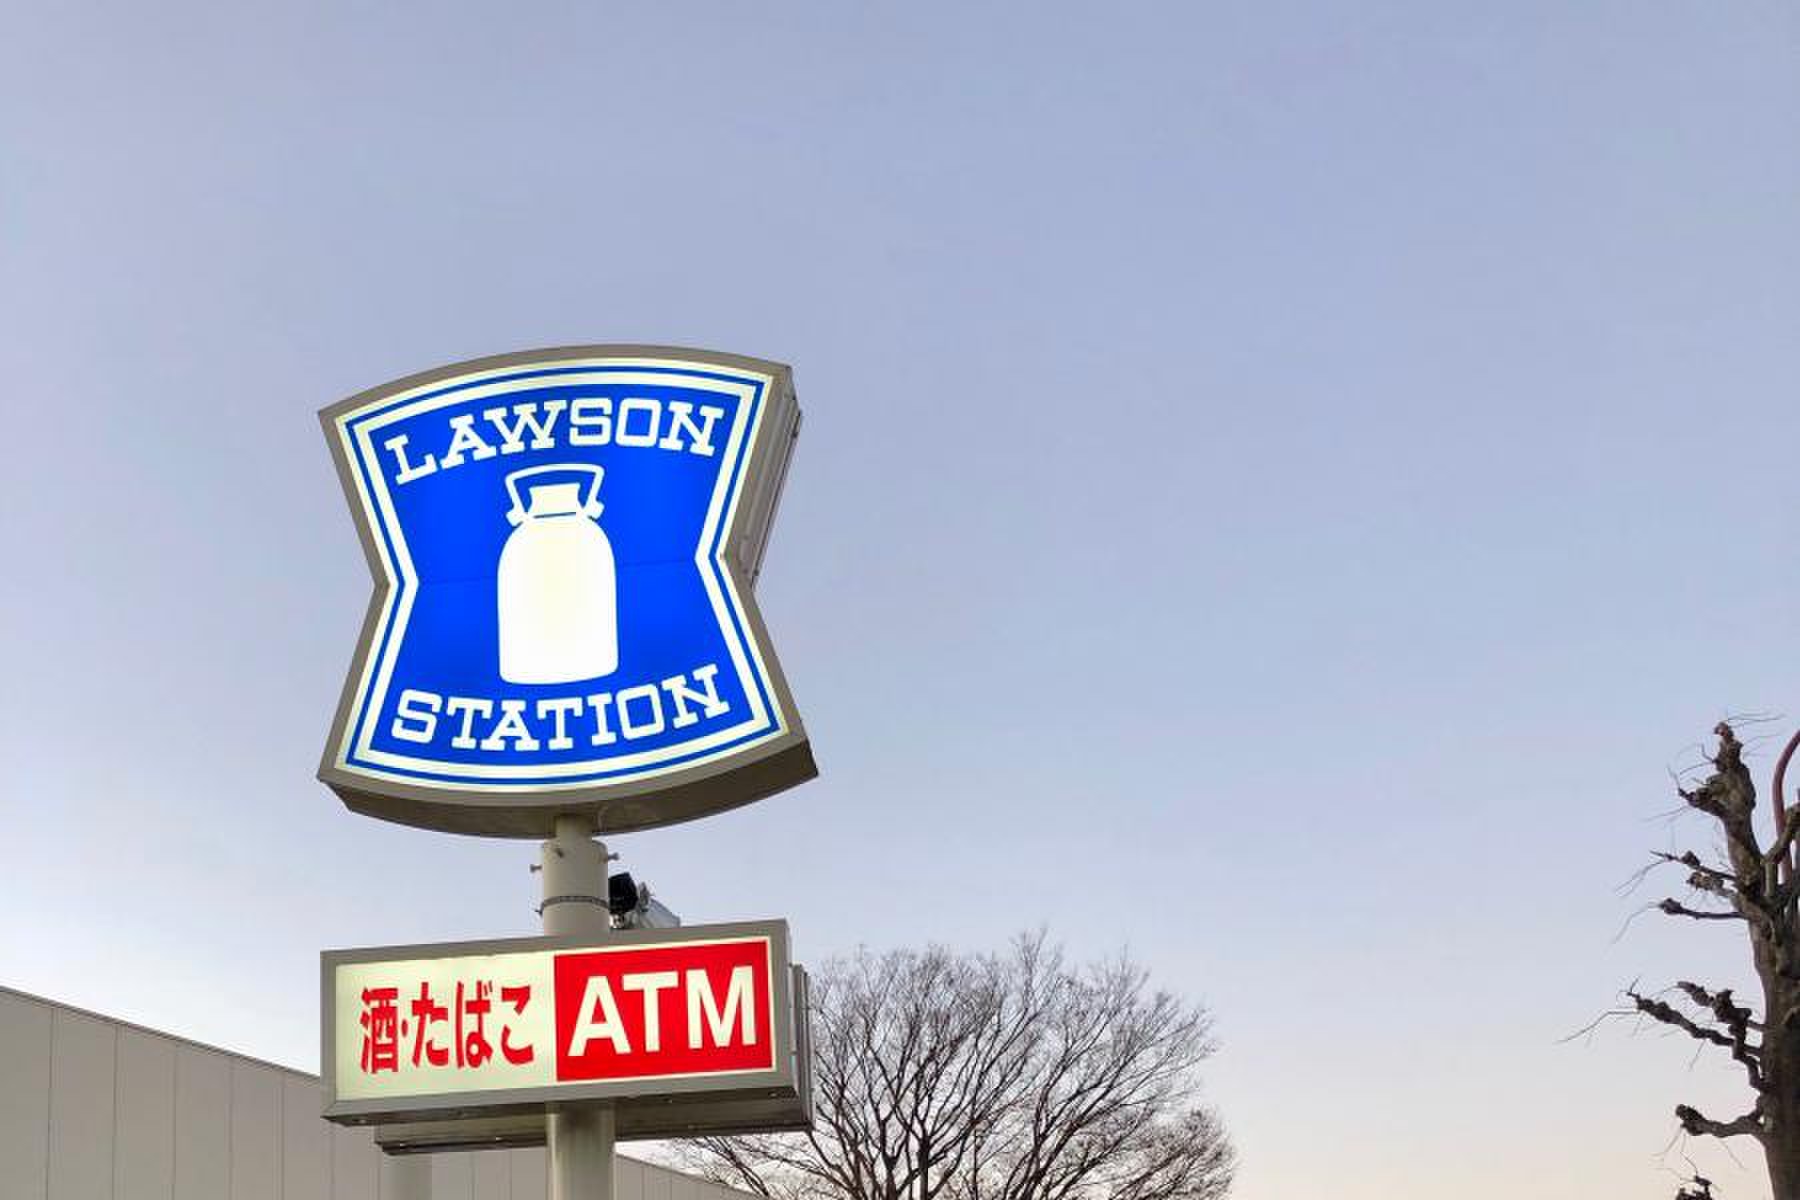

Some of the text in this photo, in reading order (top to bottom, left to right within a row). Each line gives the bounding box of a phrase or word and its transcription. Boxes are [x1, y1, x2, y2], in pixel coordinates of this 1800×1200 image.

[384, 397, 724, 486] LAWSON
[391, 663, 731, 753] STATION
[567, 965, 758, 1058] ATM
